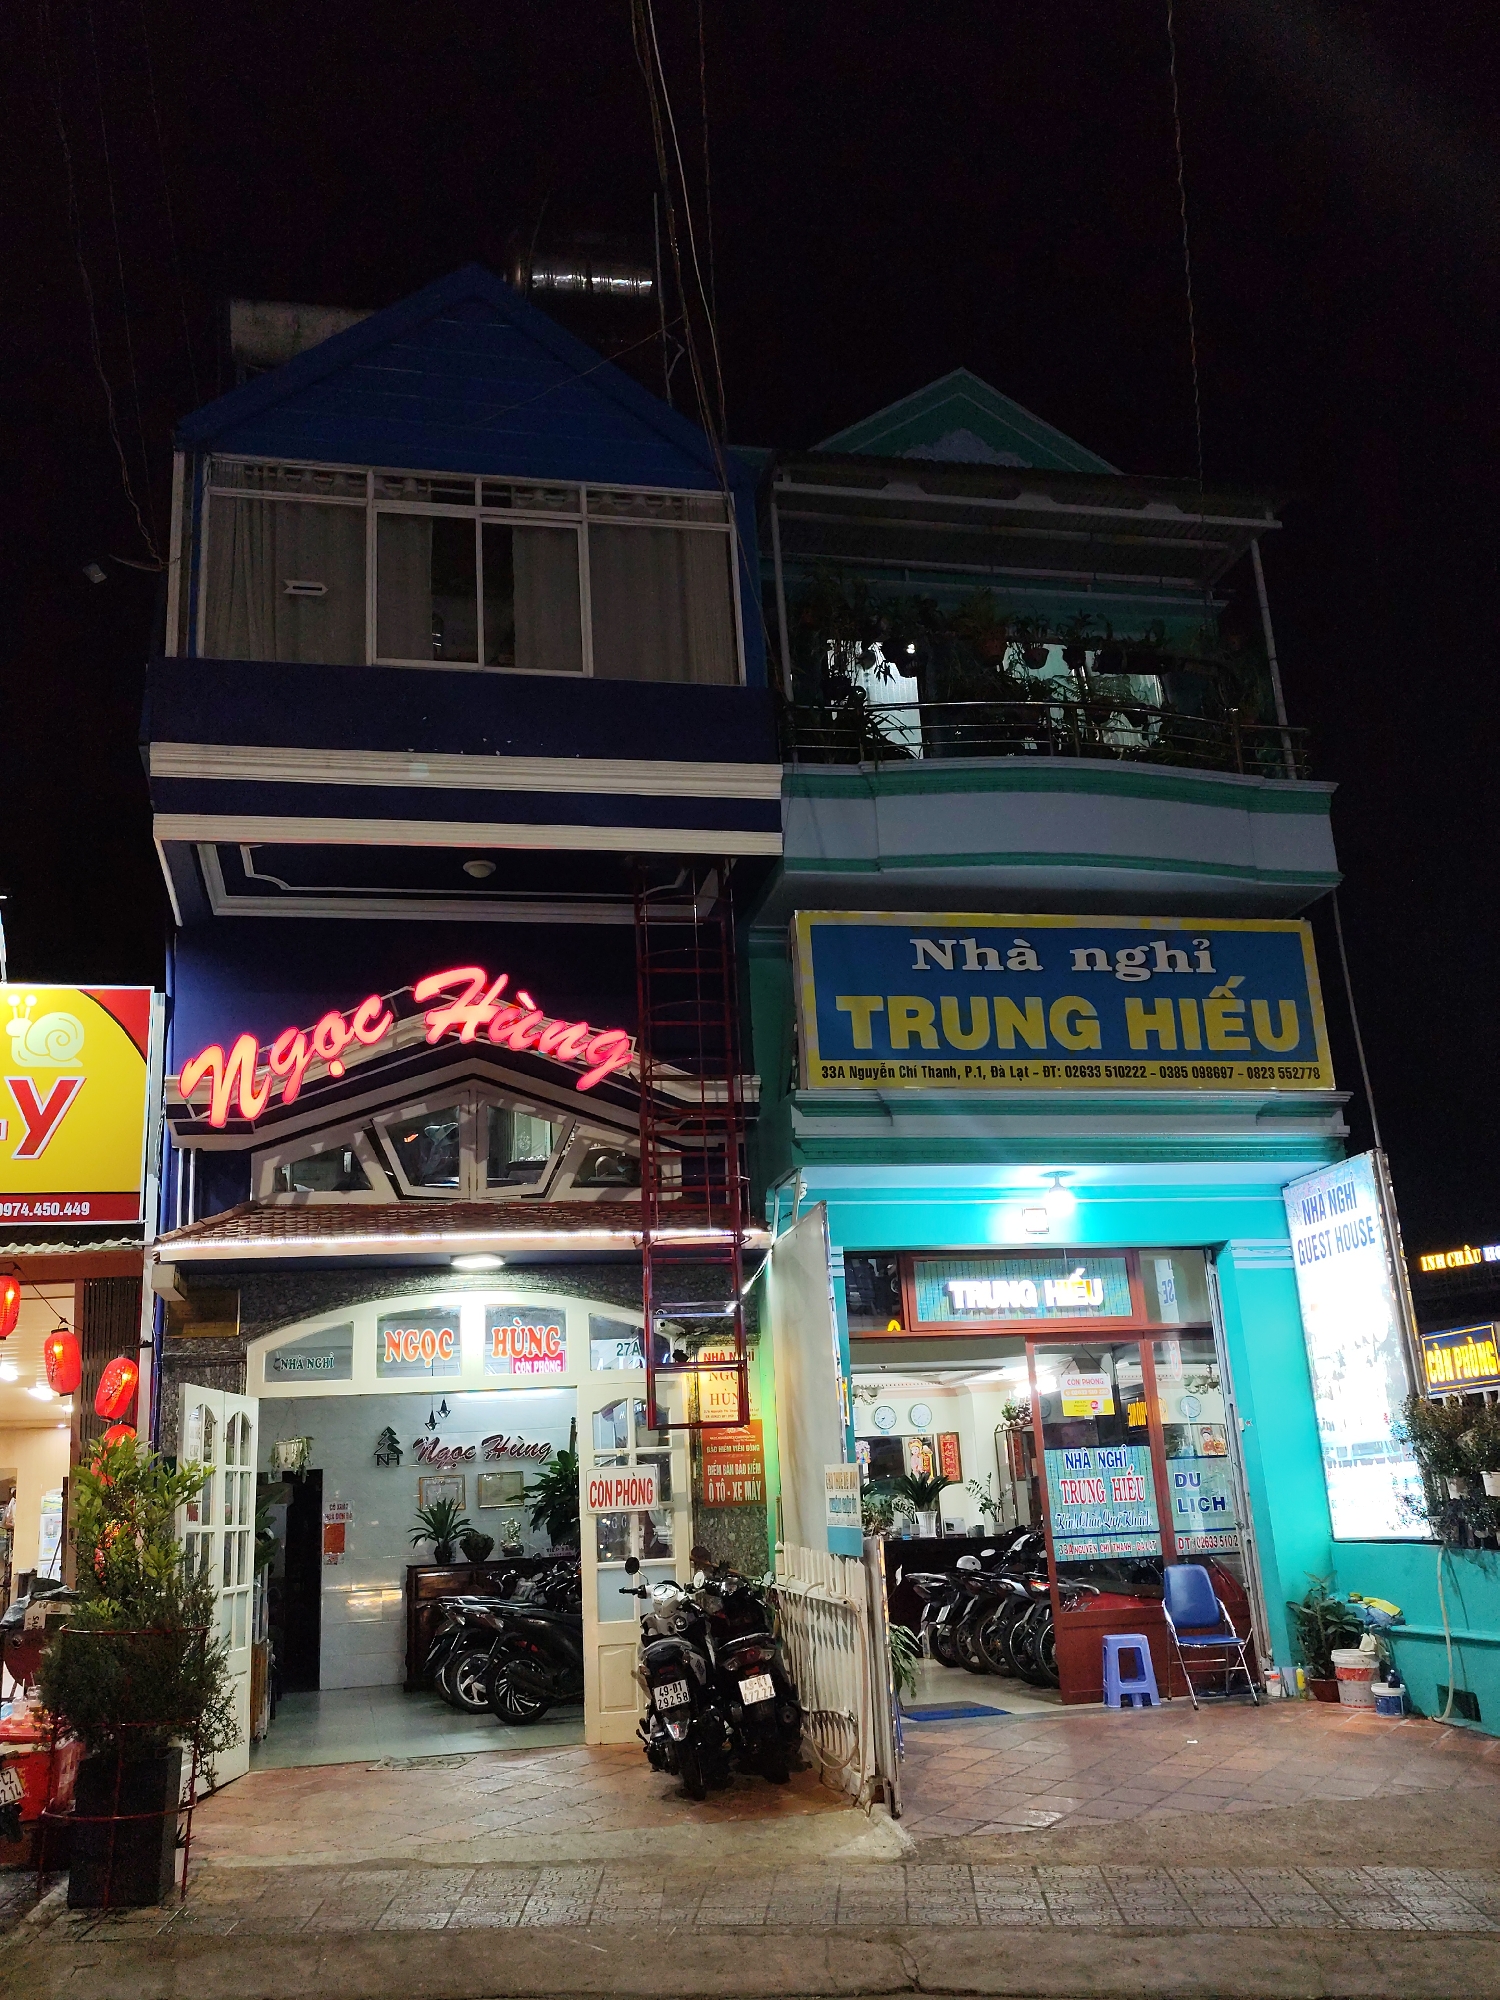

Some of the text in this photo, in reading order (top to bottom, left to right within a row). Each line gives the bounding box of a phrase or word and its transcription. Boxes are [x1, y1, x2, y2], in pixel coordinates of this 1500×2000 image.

[908, 937, 1218, 983] Nhà nghỉ
[835, 975, 1302, 1052] TRUNG HIẾU
[178, 965, 635, 1128] Ngọc Hùng
[821, 1065, 846, 1079] 33A
[849, 1061, 896, 1081] Nguyễn
[899, 1062, 918, 1079] Chí
[921, 1065, 961, 1080] Thanh,
[964, 1065, 987, 1080] P.1,
[990, 1064, 1006, 1079] Đà
[1009, 1065, 1029, 1082] Lạt
[1042, 1065, 1062, 1078] ĐT:
[1064, 1065, 1102, 1078] 02633
[1105, 1065, 1148, 1078] 510222
[1159, 1065, 1189, 1079] 0385
[1191, 1066, 1234, 1080] 098697
[1246, 1066, 1275, 1080] 0823
[1278, 1066, 1321, 1080] 552778
[1301, 1171, 1358, 1226] NHÀ NGHỈ
[1297, 1216, 1376, 1266] GUEST HOUSE
[1446, 1244, 1482, 1268] CHÂU
[948, 1267, 1104, 1309] TRUNG HIẾU
[383, 1316, 562, 1368] NGỌC HÙNG
[616, 1342, 641, 1357] 27A
[703, 1349, 726, 1361] NHÀ
[281, 1351, 335, 1370] NHÀ NGHỈ
[514, 1357, 562, 1374] CÒN PHÒNG
[1426, 1336, 1499, 1384] CÒN PHÒNG
[376, 1453, 400, 1467] NH
[412, 1434, 553, 1470] Ngọc Hùng
[1065, 1444, 1128, 1470] NHÀ NGHỈ
[589, 1471, 653, 1508] CÒN PHÒNG
[715, 1477, 726, 1503] TÔ
[732, 1481, 743, 1502] XE
[744, 1476, 762, 1501] MÁY
[1060, 1464, 1145, 1504] TRUNG HIẾU
[1174, 1472, 1201, 1488] DU
[1196, 1535, 1219, 1549] 02633
